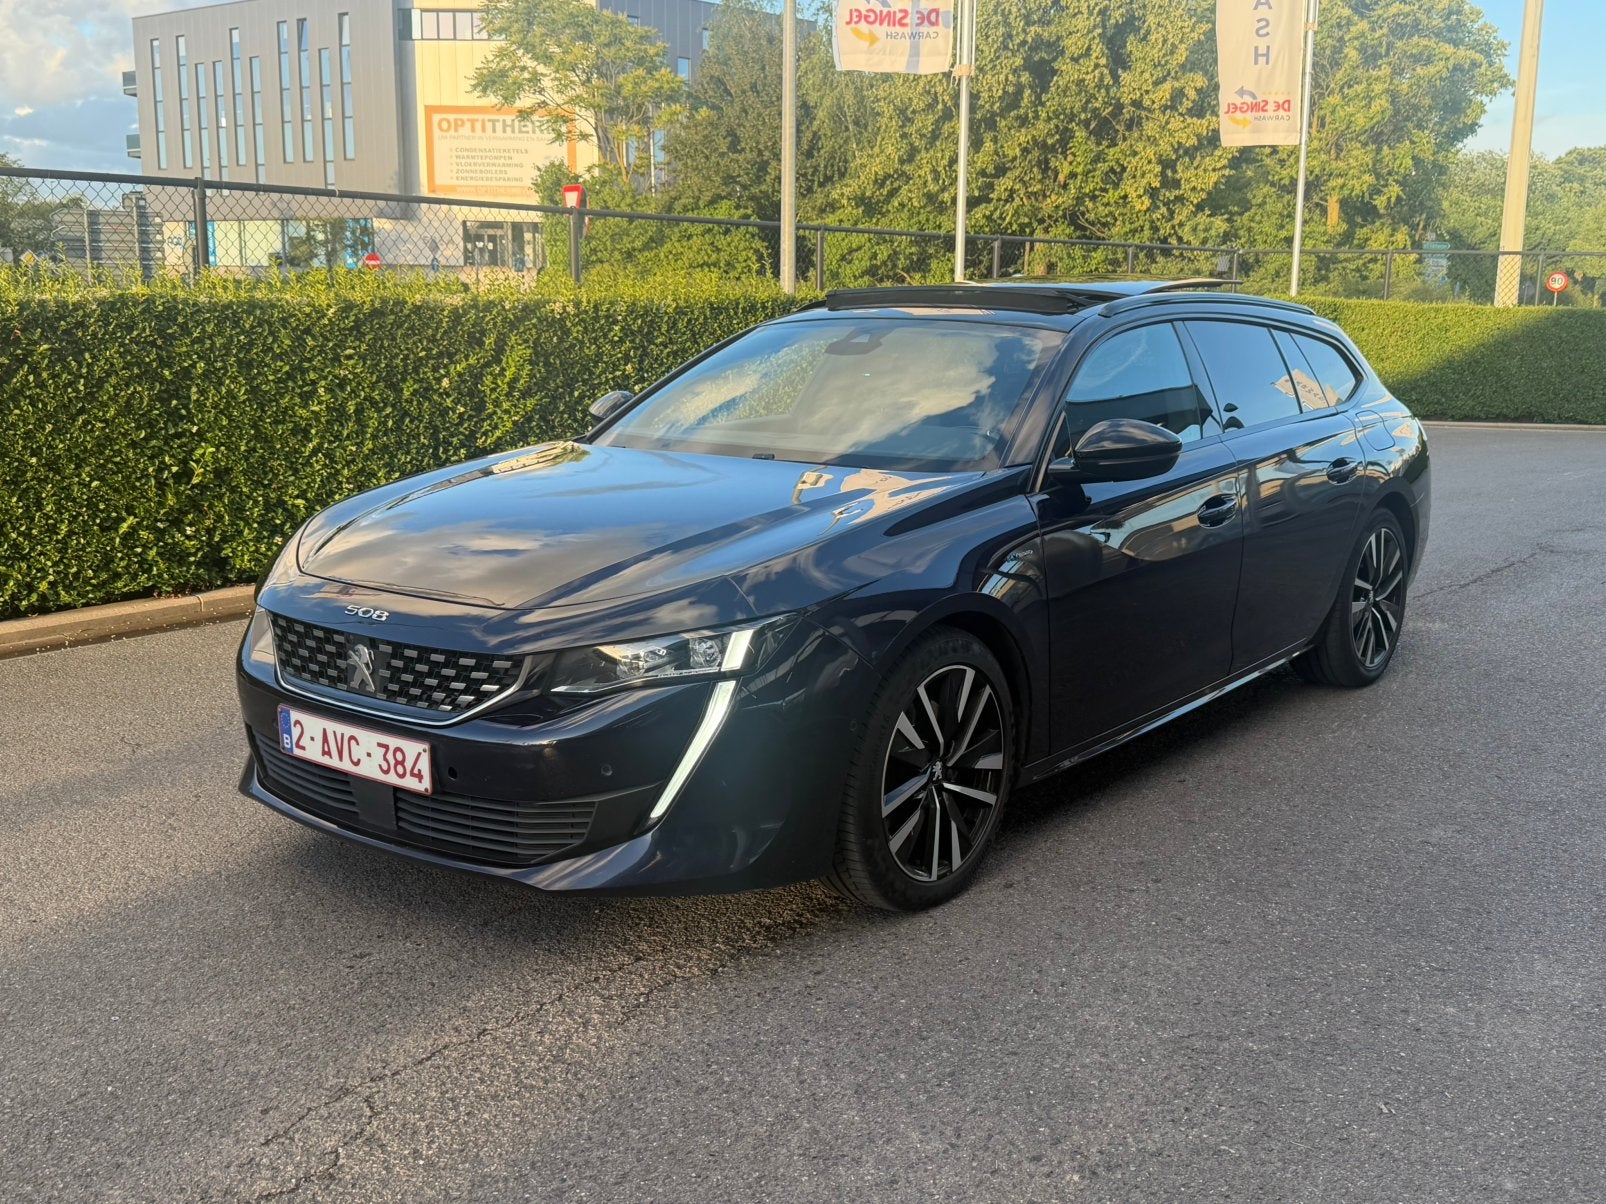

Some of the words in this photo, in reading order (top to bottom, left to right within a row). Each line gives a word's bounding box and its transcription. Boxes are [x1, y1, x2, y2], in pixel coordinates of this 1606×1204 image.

[437, 117, 553, 134] OPTITHER
[1551, 277, 1563, 285] 90
[344, 604, 389, 622] 508
[283, 734, 291, 749] B
[293, 719, 424, 784] 2-AVC-384
